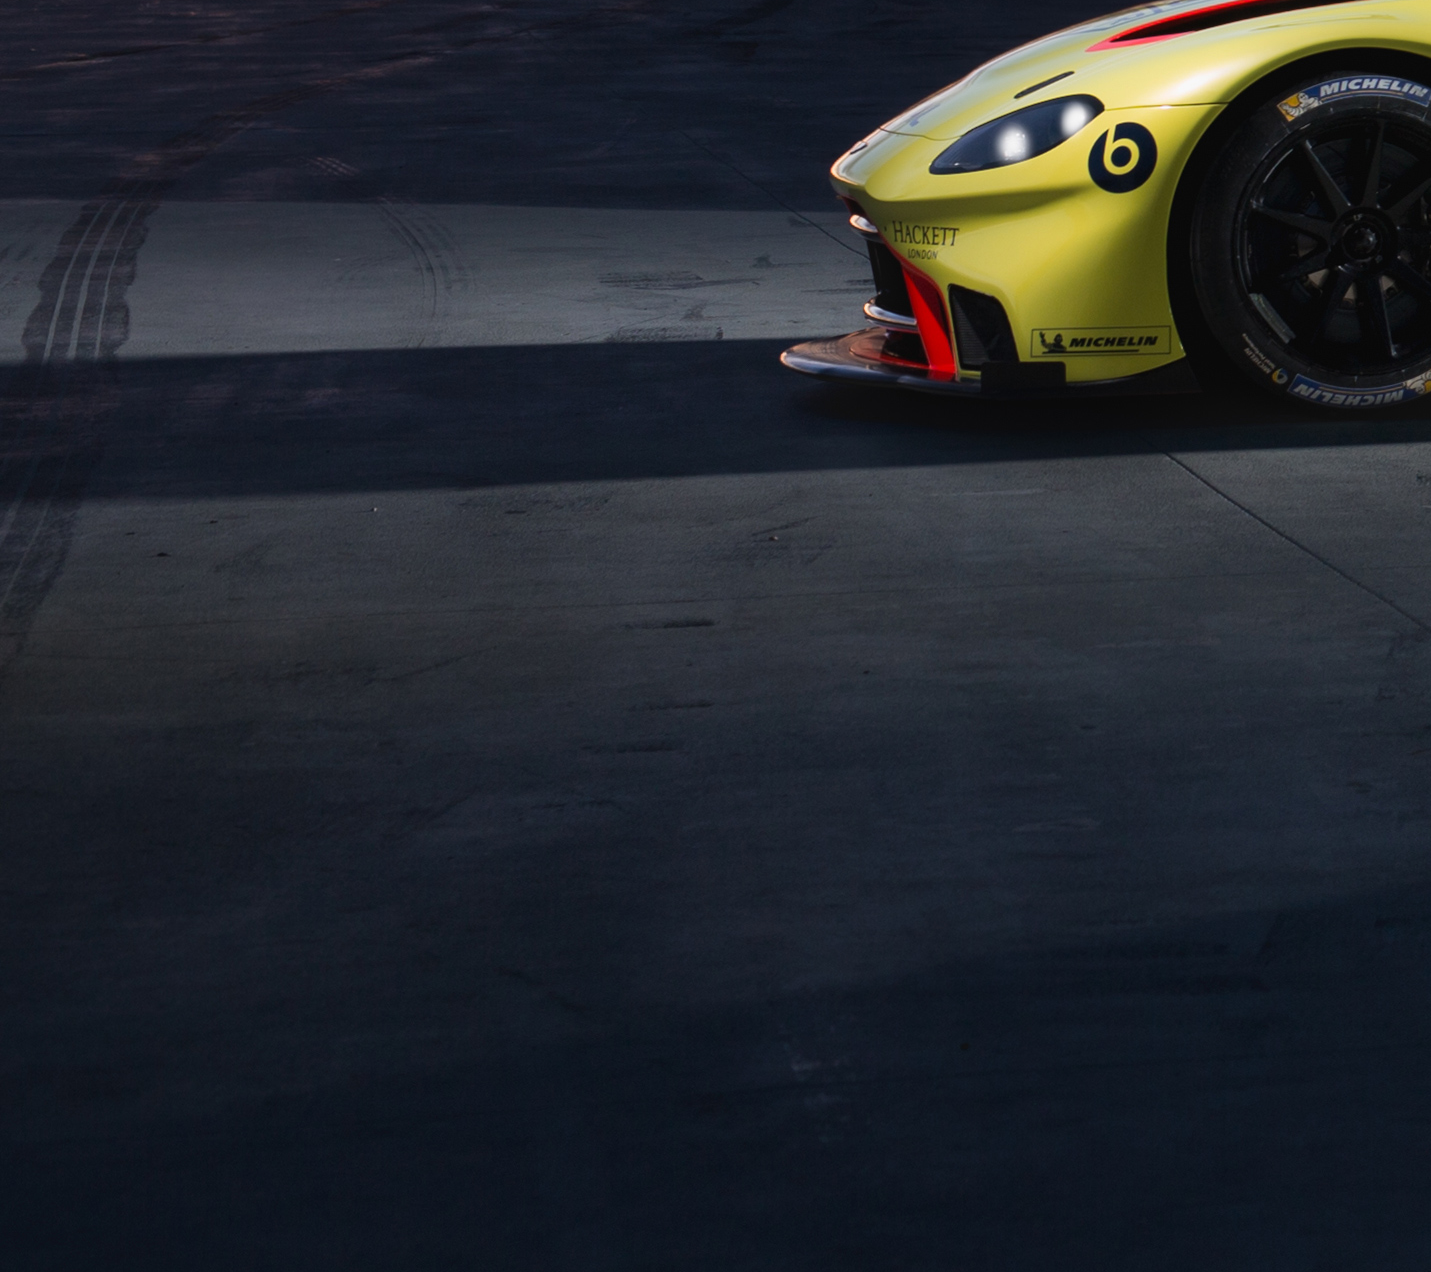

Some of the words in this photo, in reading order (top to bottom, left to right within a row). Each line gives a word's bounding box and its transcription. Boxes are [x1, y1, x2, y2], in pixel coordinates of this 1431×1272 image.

[1319, 78, 1429, 98] MICHELIN
[892, 220, 960, 247] HACKETT
[907, 248, 939, 260] LONDON
[1069, 335, 1159, 348] MICHELIN
[1293, 382, 1405, 407] MICHELIN
